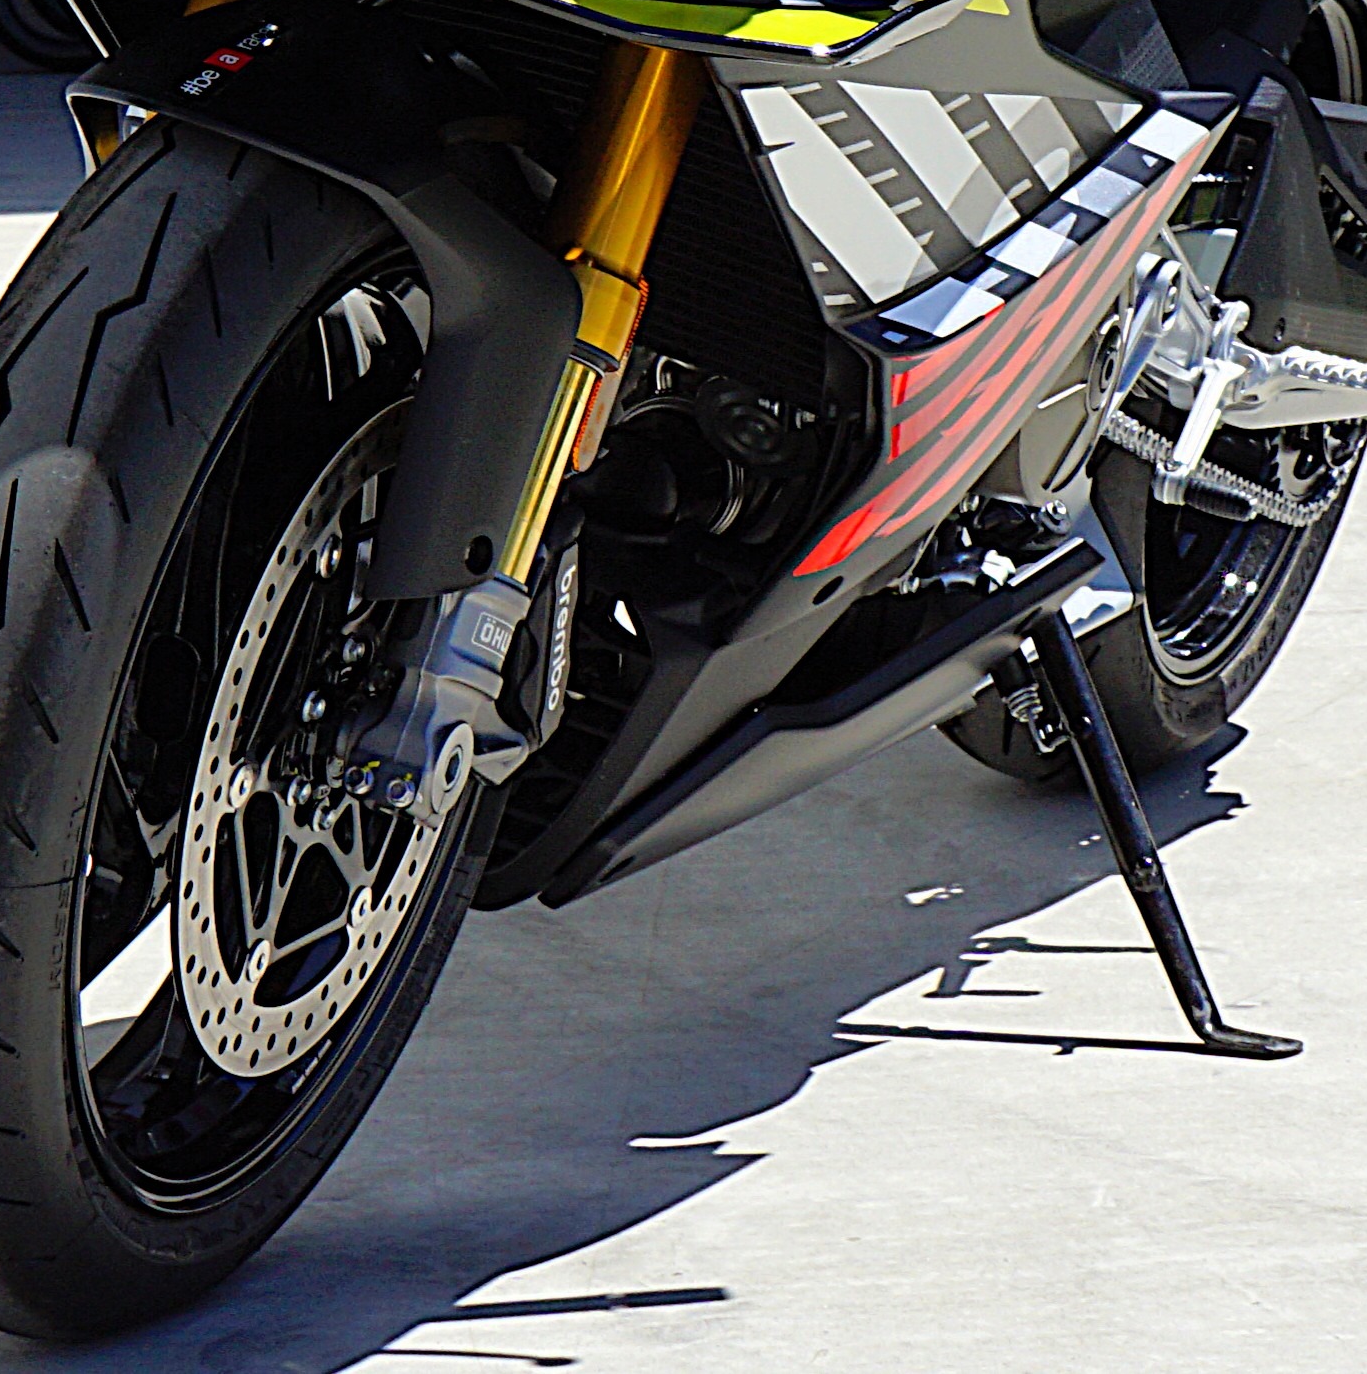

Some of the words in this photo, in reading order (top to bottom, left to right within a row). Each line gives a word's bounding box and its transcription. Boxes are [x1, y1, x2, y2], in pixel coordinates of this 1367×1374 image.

[180, 69, 220, 96] #be
[219, 54, 239, 65] a
[548, 564, 577, 711] brembo
